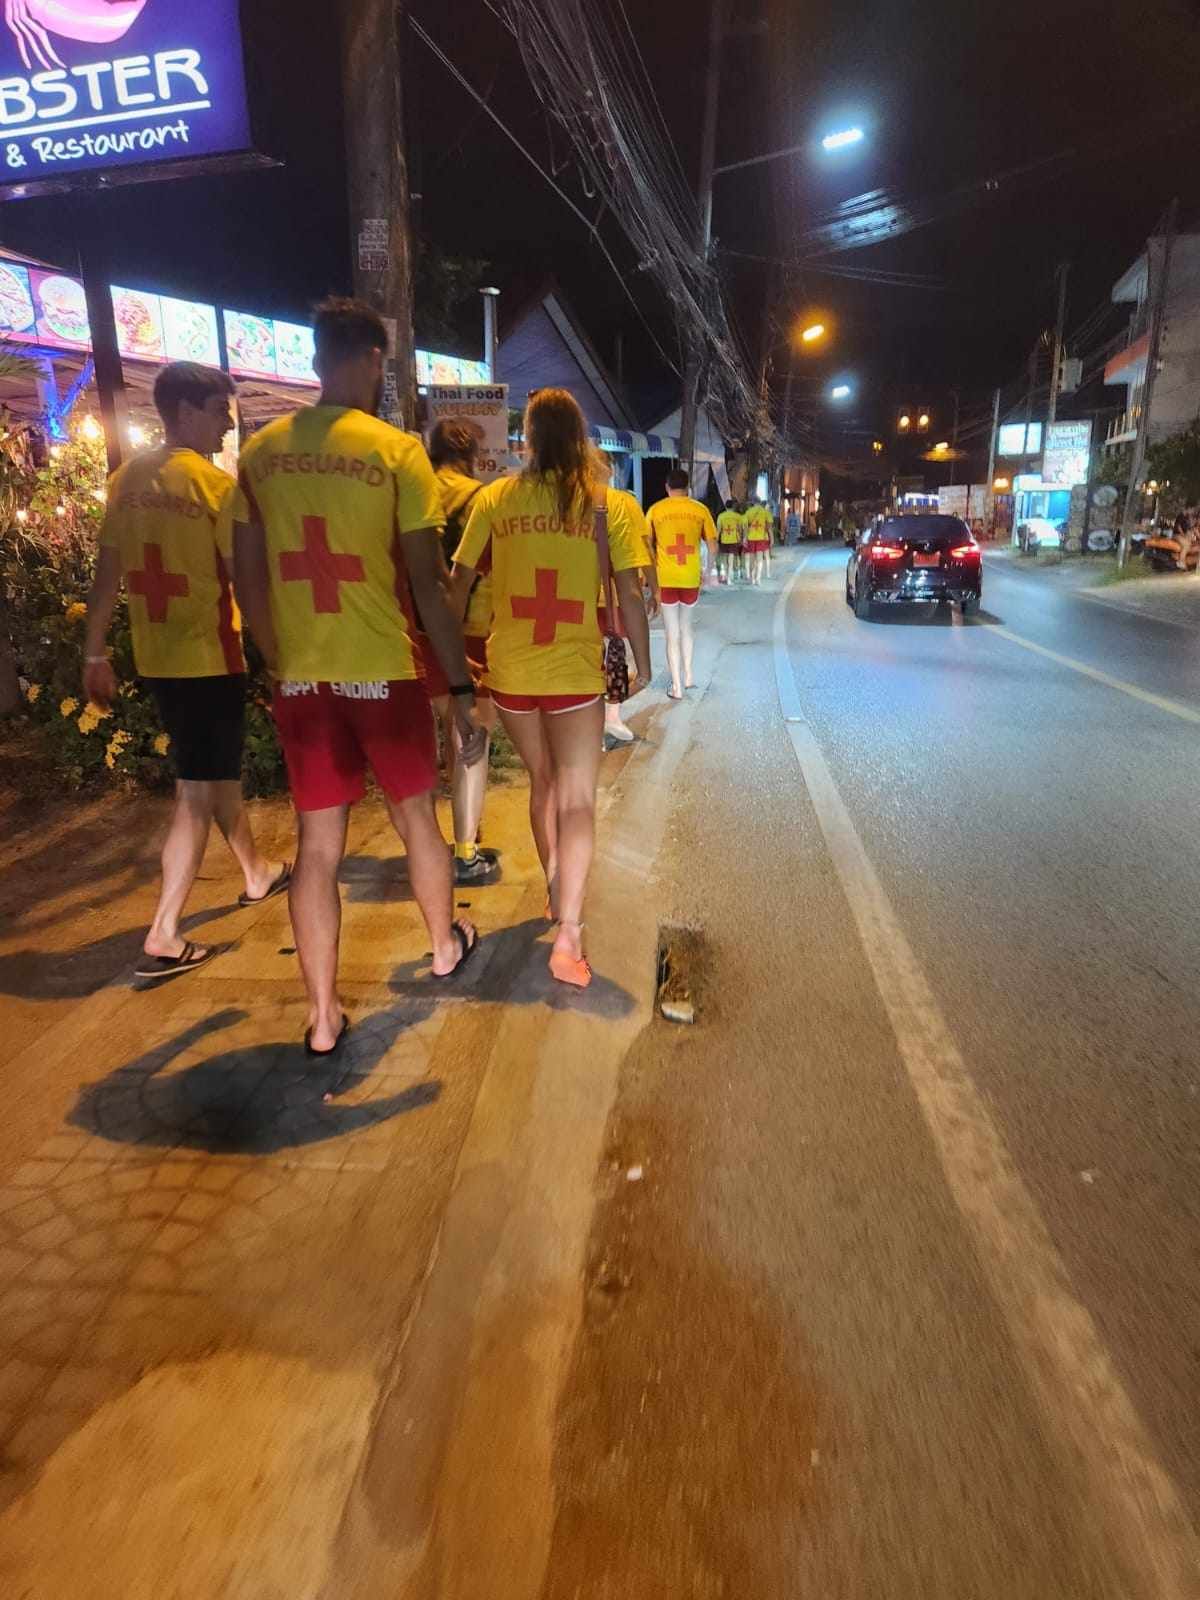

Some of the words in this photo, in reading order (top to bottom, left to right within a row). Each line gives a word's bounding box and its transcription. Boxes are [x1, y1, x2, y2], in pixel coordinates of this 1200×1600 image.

[6, 143, 27, 168] &
[31, 119, 190, 164] Restaurant
[431, 387, 462, 399] Thai
[466, 387, 504, 400] Food
[330, 680, 389, 700] ENDING
